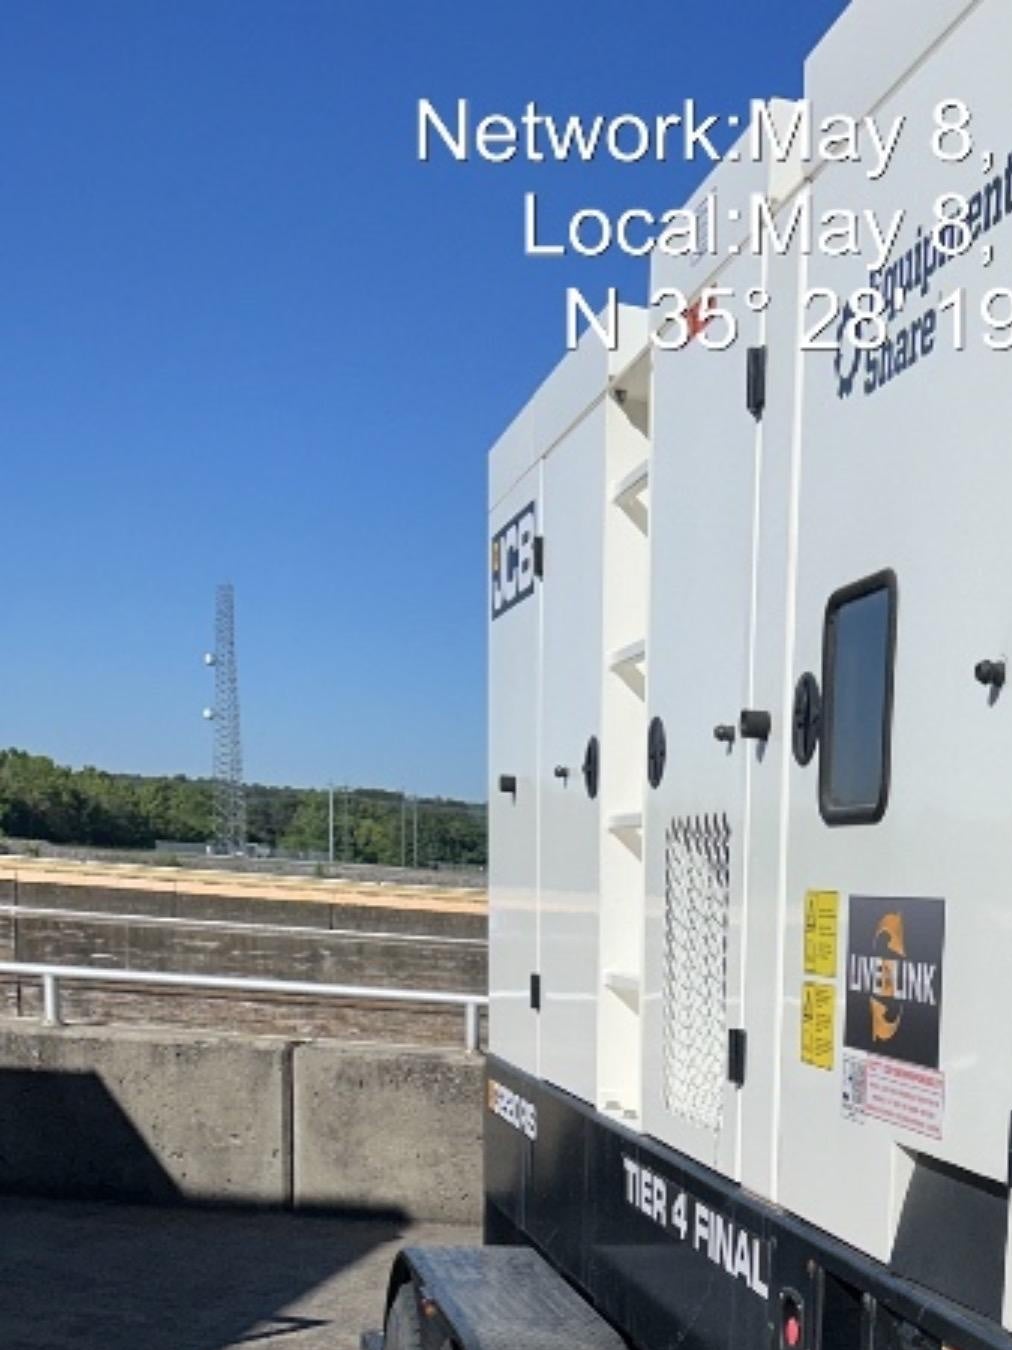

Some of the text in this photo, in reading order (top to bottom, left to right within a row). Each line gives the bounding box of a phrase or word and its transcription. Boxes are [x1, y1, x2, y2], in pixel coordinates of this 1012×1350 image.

[621, 1155, 769, 1300] TIER 4 FINAL
